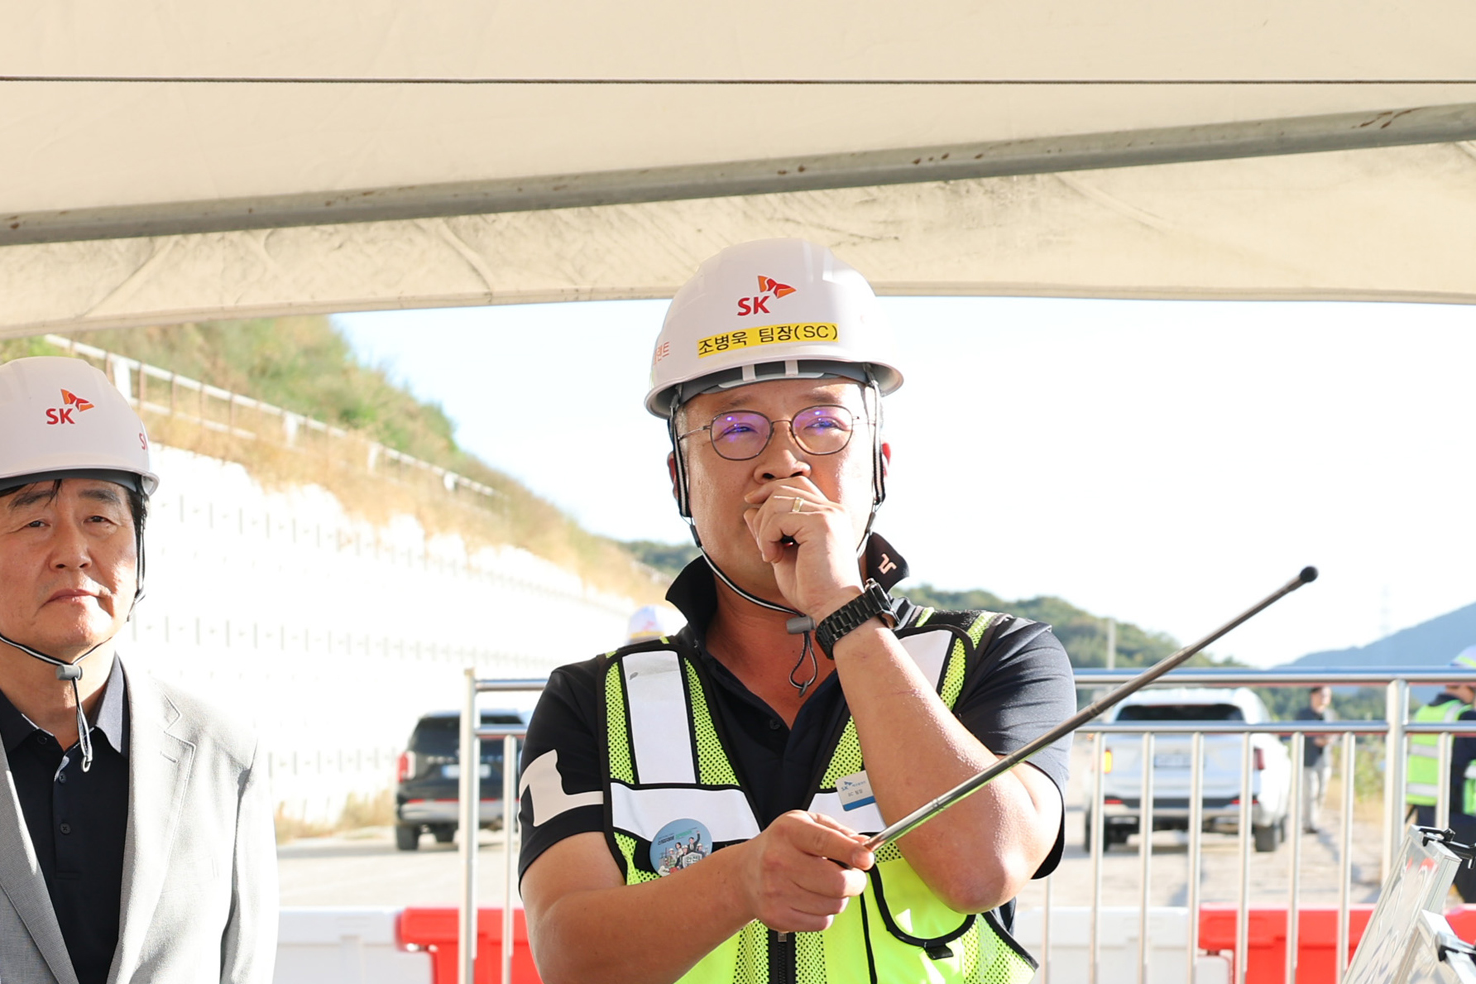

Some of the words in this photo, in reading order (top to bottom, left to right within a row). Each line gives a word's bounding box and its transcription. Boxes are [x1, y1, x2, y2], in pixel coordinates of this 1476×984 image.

[737, 296, 770, 316] SK
[698, 331, 748, 355] 조병욱
[759, 325, 838, 343] 팀장(SC)
[46, 408, 76, 425] SK
